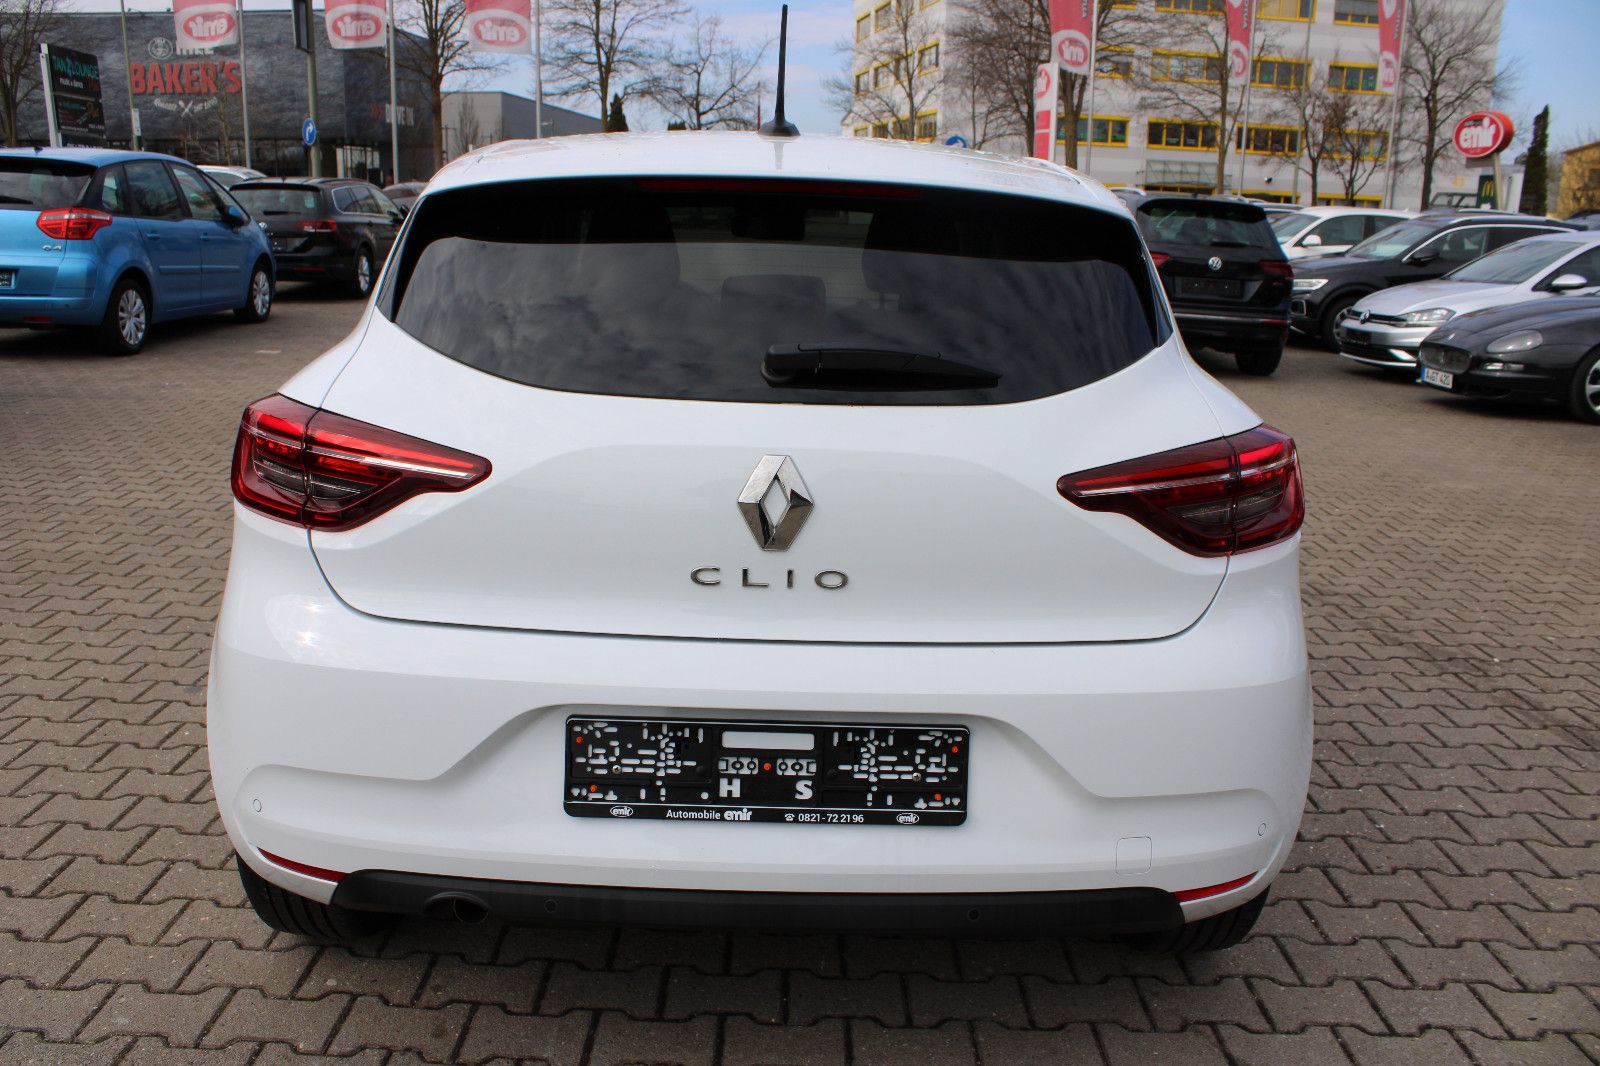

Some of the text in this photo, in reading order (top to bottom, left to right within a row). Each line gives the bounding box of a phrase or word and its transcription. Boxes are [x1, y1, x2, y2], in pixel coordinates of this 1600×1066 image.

[129, 60, 242, 95] BAKER'S
[1459, 116, 1497, 148] emir
[690, 565, 849, 590] CLIO
[611, 806, 632, 816] emir
[665, 807, 753, 821] Automobile emir
[898, 812, 917, 823] emir
